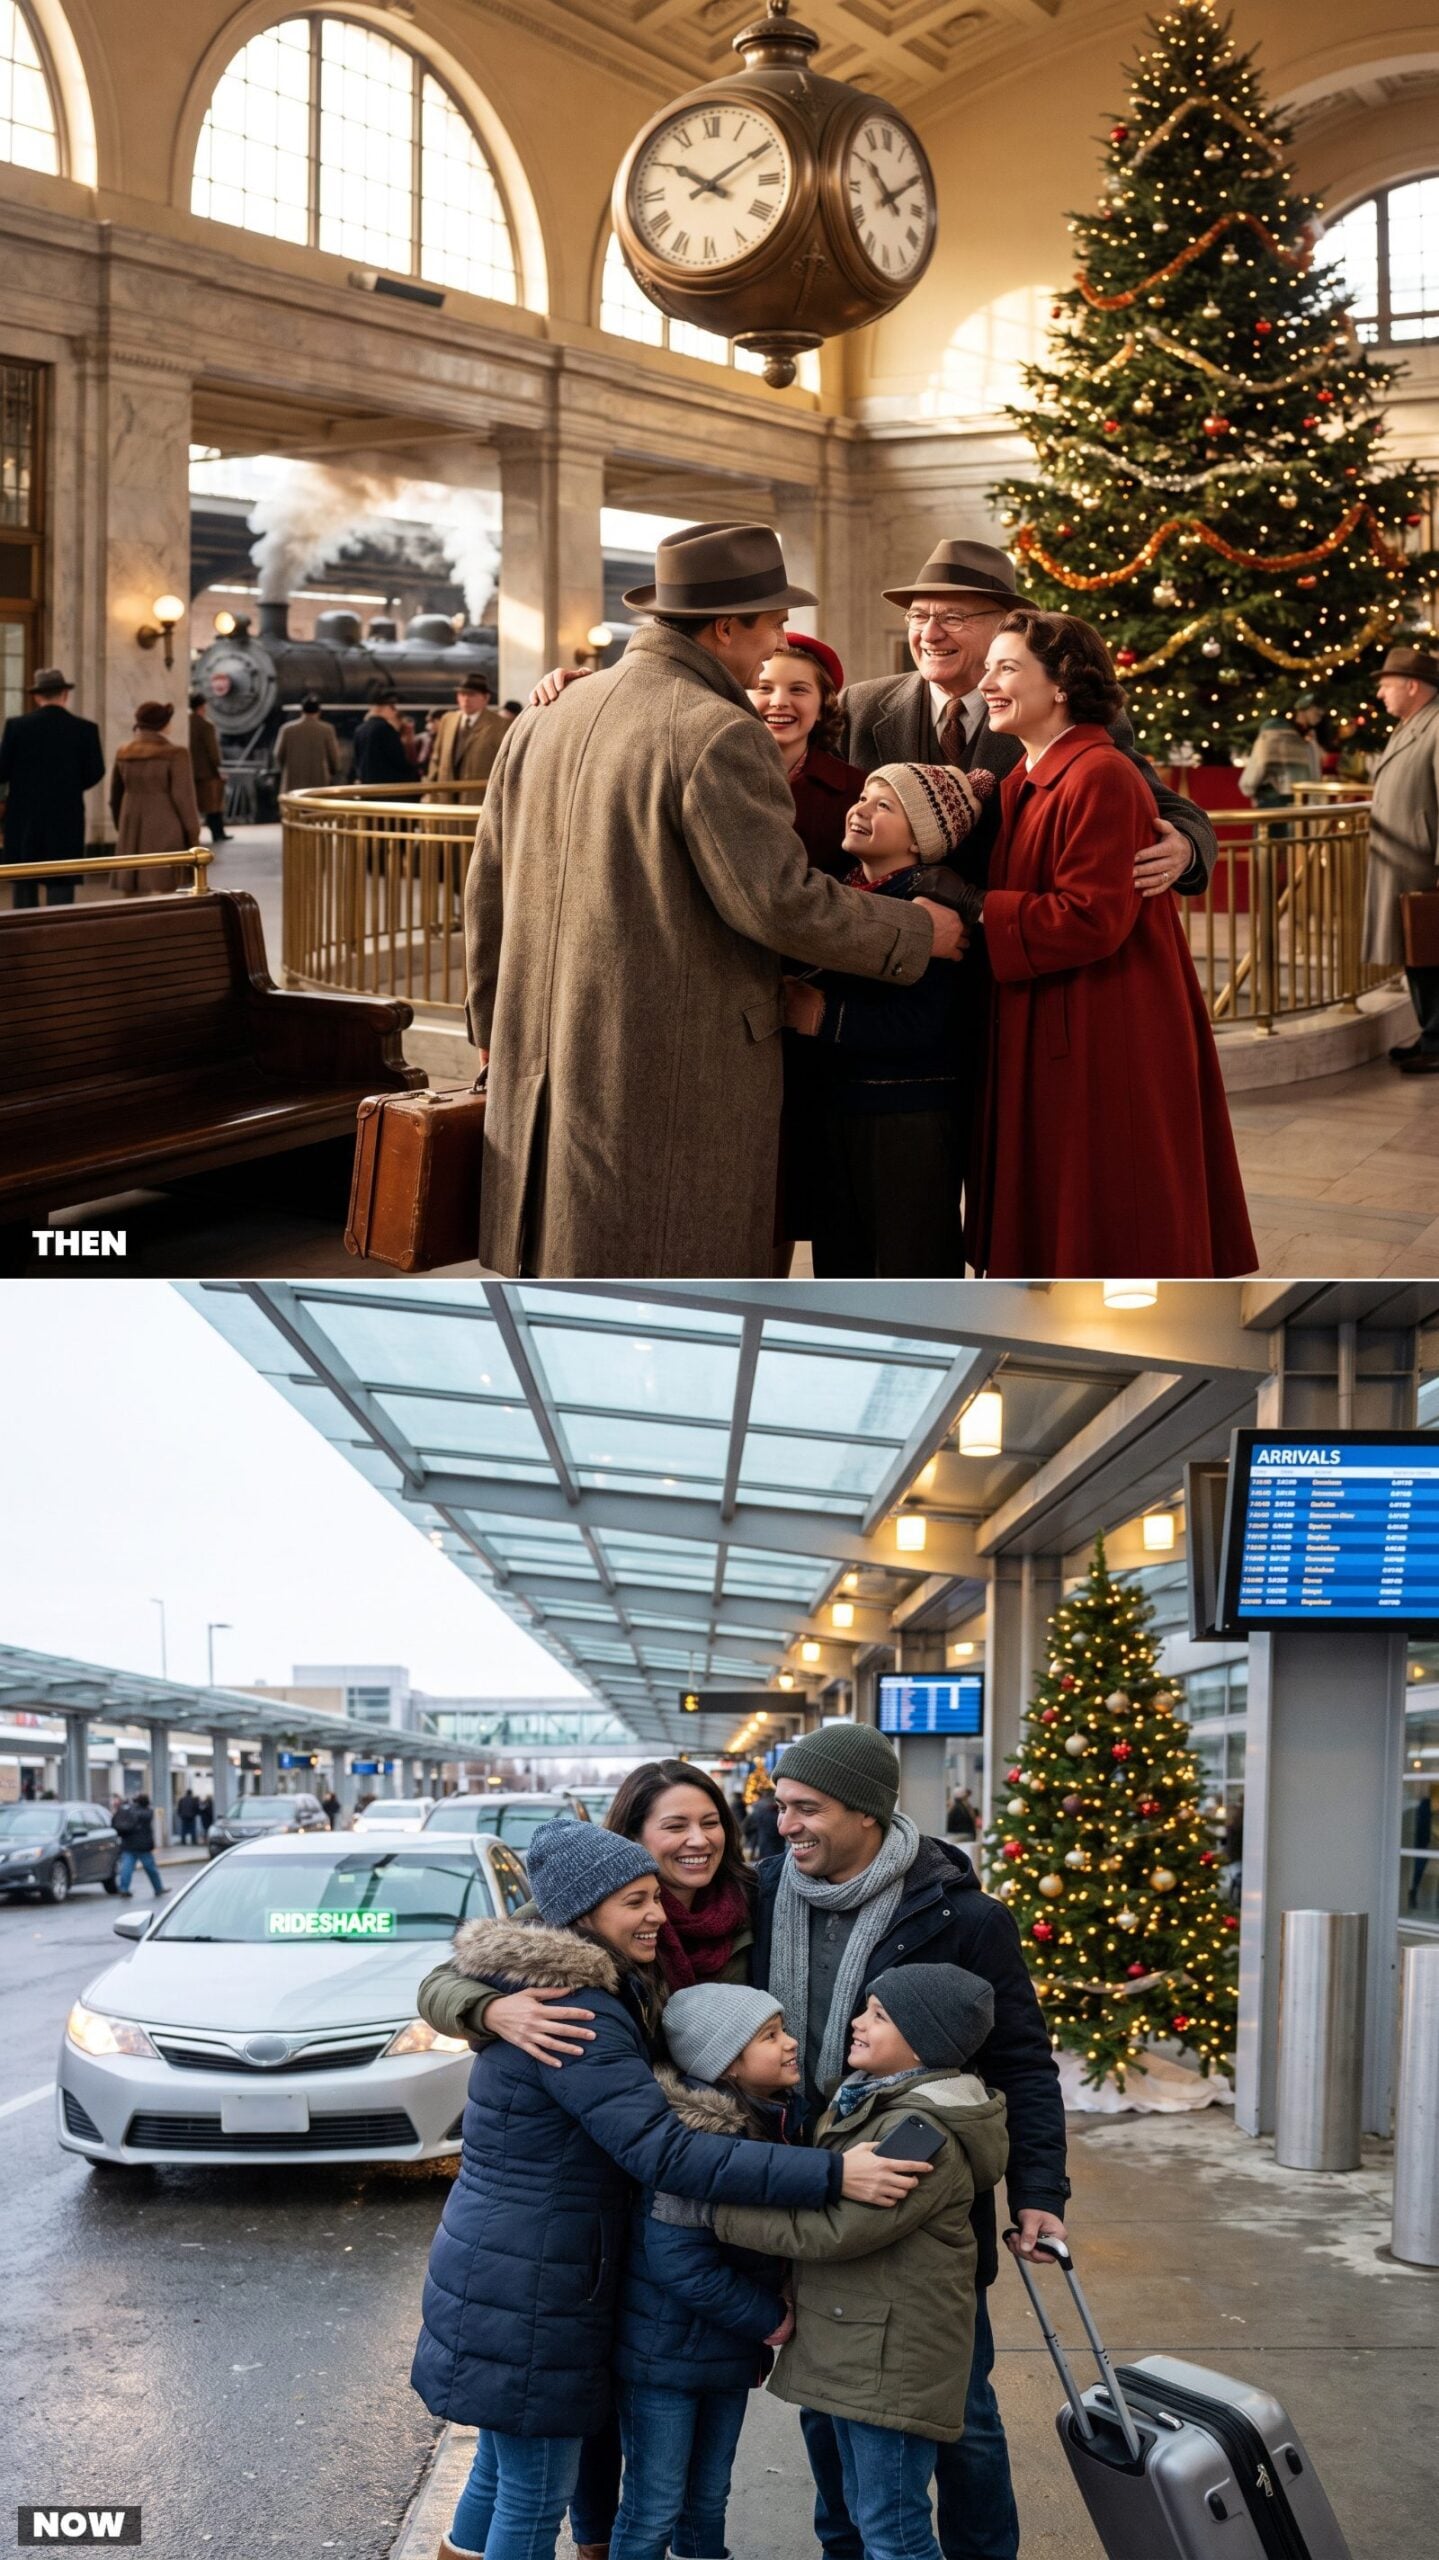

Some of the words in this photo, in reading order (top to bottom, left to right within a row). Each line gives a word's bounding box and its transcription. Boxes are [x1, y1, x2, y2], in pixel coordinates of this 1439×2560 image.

[758, 172, 781, 186] III
[1257, 1449, 1341, 1465] ARRIVALS
[269, 1912, 391, 1934] RIDESHARE
